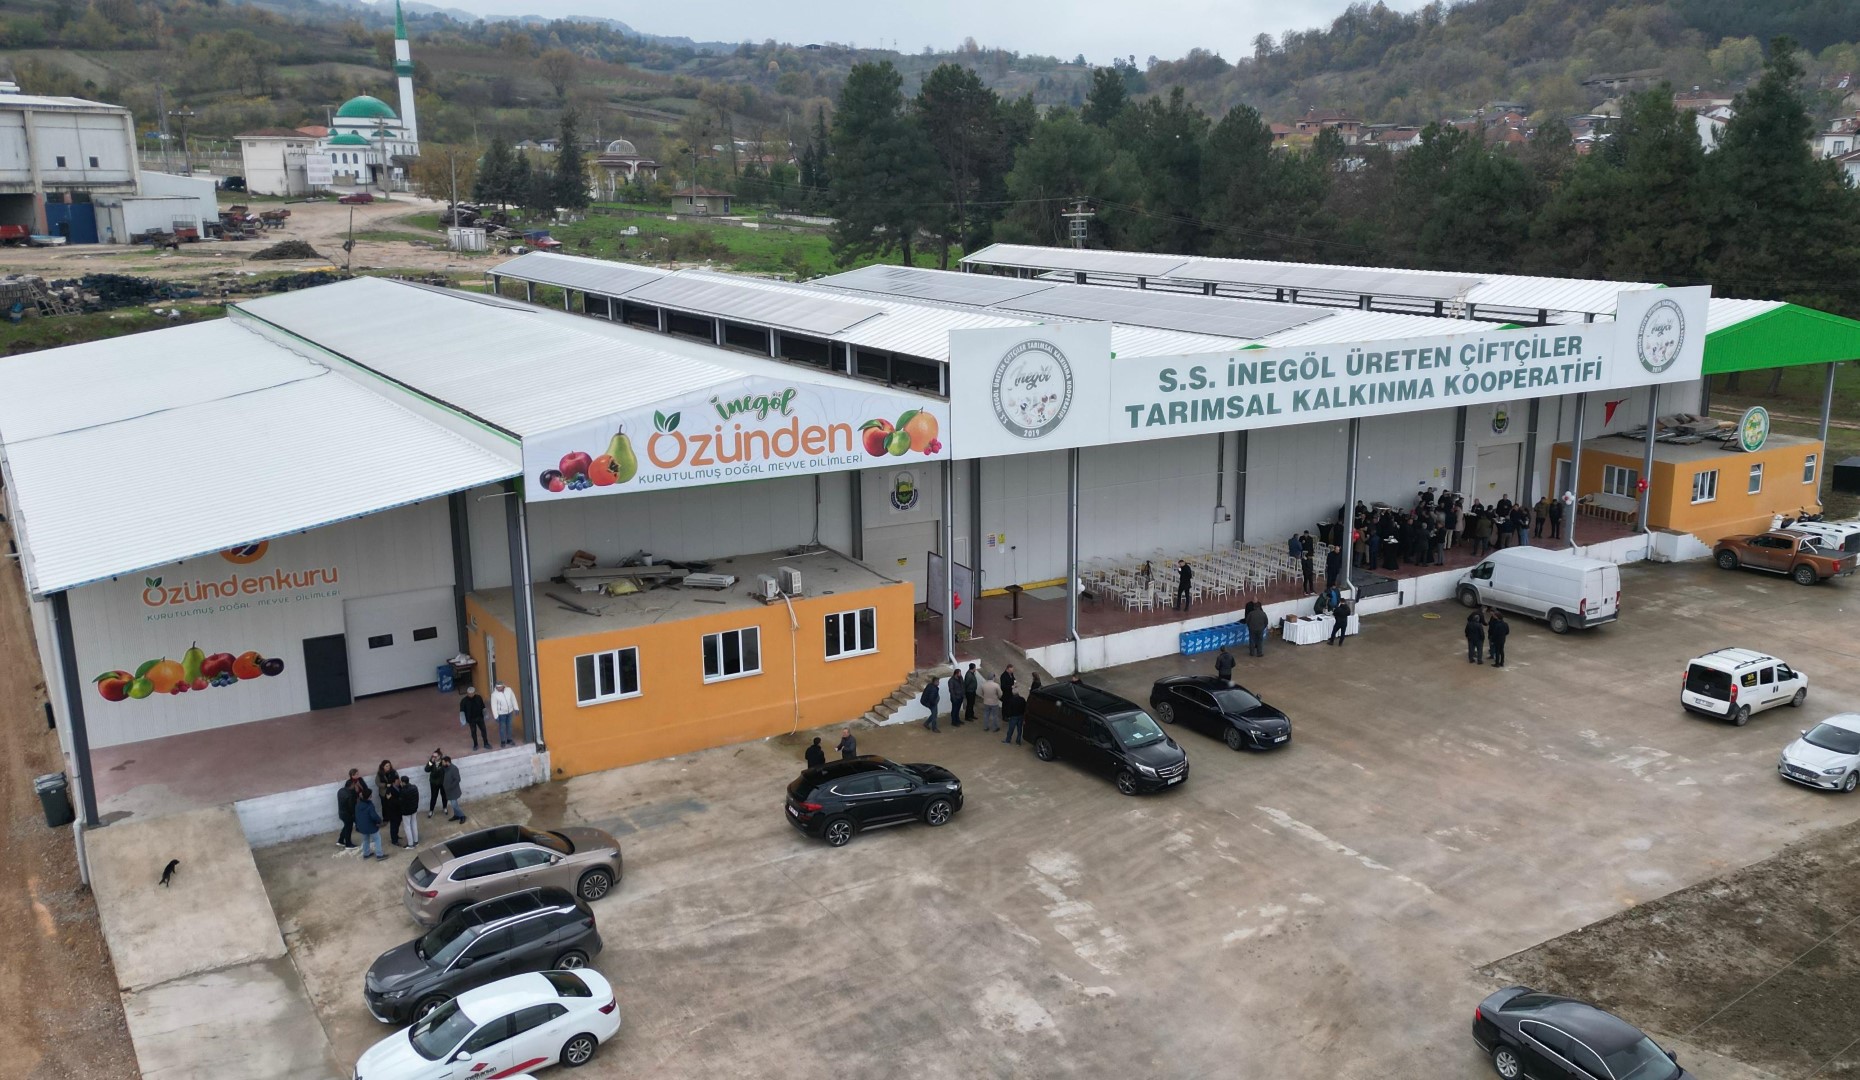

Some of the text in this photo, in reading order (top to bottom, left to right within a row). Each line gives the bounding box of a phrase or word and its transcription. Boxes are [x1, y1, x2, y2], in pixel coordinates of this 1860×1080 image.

[1158, 333, 1583, 393] S.S. İNEGÖL ÜRETEN ÇİFTÇİLER
[1124, 355, 1603, 429] TARIMSAL KALKINMA KOOPERATİFİ
[646, 413, 853, 469] Özünden
[1023, 429, 1040, 437] 2019
[638, 454, 864, 484] KURUTULMUŞ DOĞAL MEYVE DİLİMLERİ
[142, 567, 339, 606] Özündenkuru
[147, 607, 214, 621] KURUTULMUŞ
[219, 602, 250, 612] DOĞAL
[257, 597, 289, 606] MEYVE
